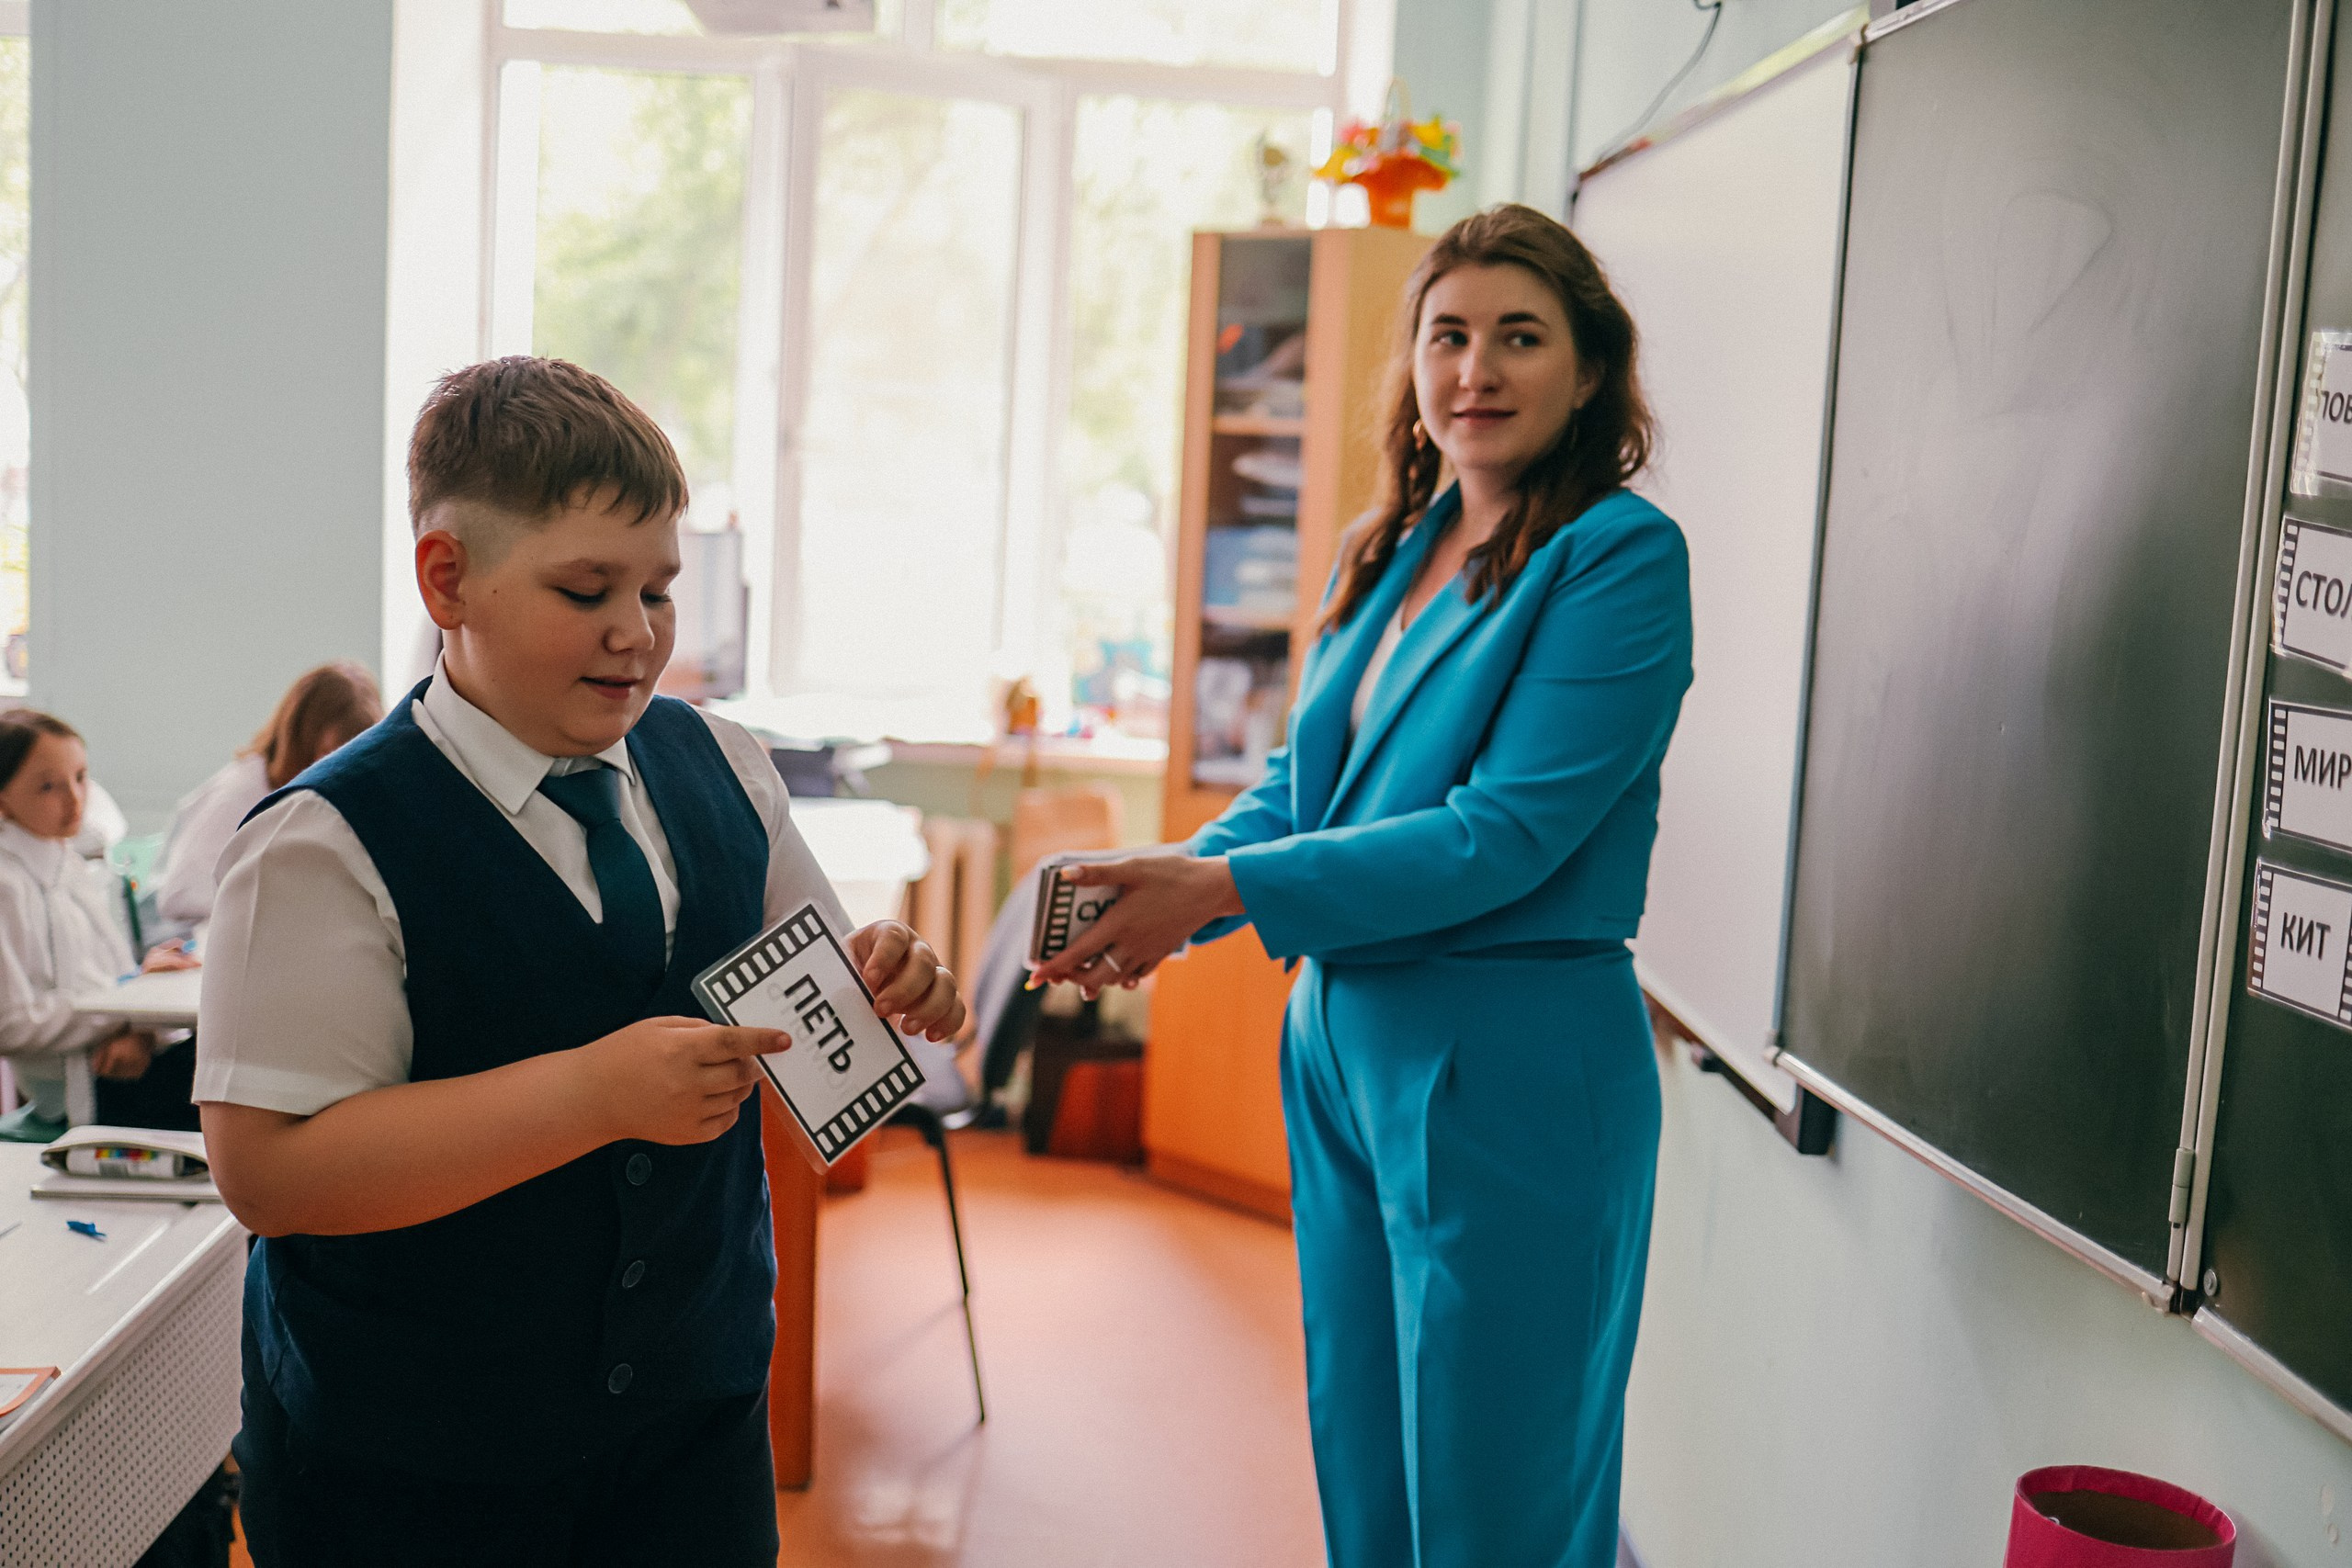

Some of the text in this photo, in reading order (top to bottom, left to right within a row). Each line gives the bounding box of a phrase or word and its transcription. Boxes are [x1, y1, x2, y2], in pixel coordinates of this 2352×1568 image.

[2294, 745, 2352, 789] МИР
[1077, 897, 1116, 921] СУ
[2280, 912, 2331, 960] КИТ
[784, 974, 854, 1074] ПЕТЬ
